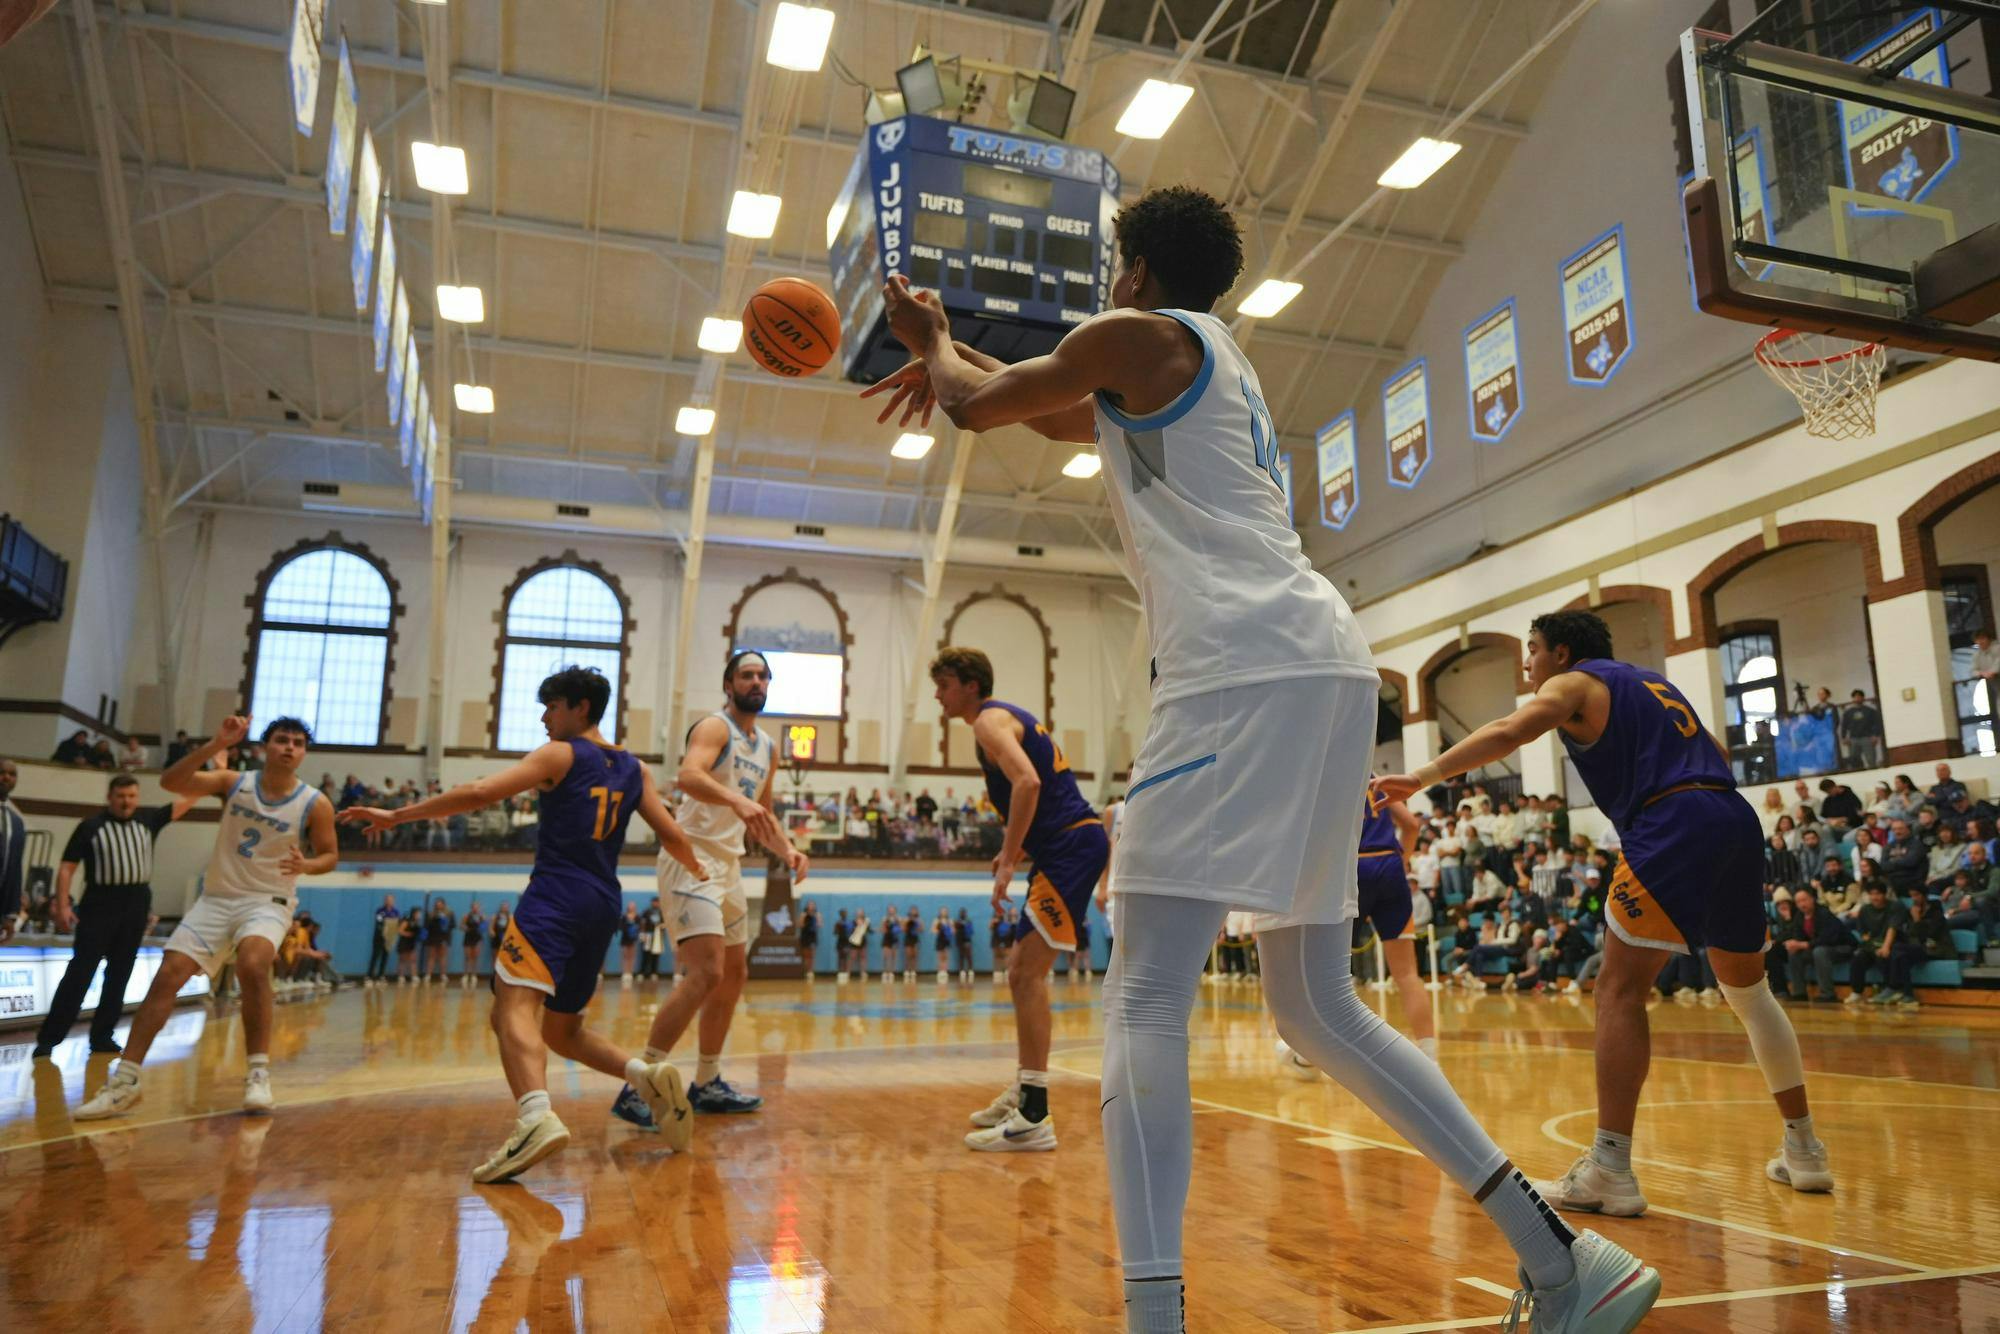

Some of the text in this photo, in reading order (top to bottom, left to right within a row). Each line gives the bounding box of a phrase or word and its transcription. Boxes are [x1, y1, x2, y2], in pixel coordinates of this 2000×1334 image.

[948, 126, 1066, 170] TUFTS
[919, 192, 964, 215] TUFTS
[988, 212, 1024, 229] PERIOD
[1046, 215, 1092, 236] GUEST
[910, 244, 943, 260] FOULS
[971, 254, 1035, 275] PLAYER FOUL
[1063, 269, 1094, 285] FOULS
[1577, 265, 1608, 295] NCAA
[774, 319, 813, 351] EVO
[1641, 680, 1698, 738] 5
[734, 755, 767, 780] TUFT
[230, 803, 290, 833] TUFTS
[238, 827, 261, 858] 2
[1039, 897, 1064, 928] Ephs
[1612, 881, 1643, 919] Ephs
